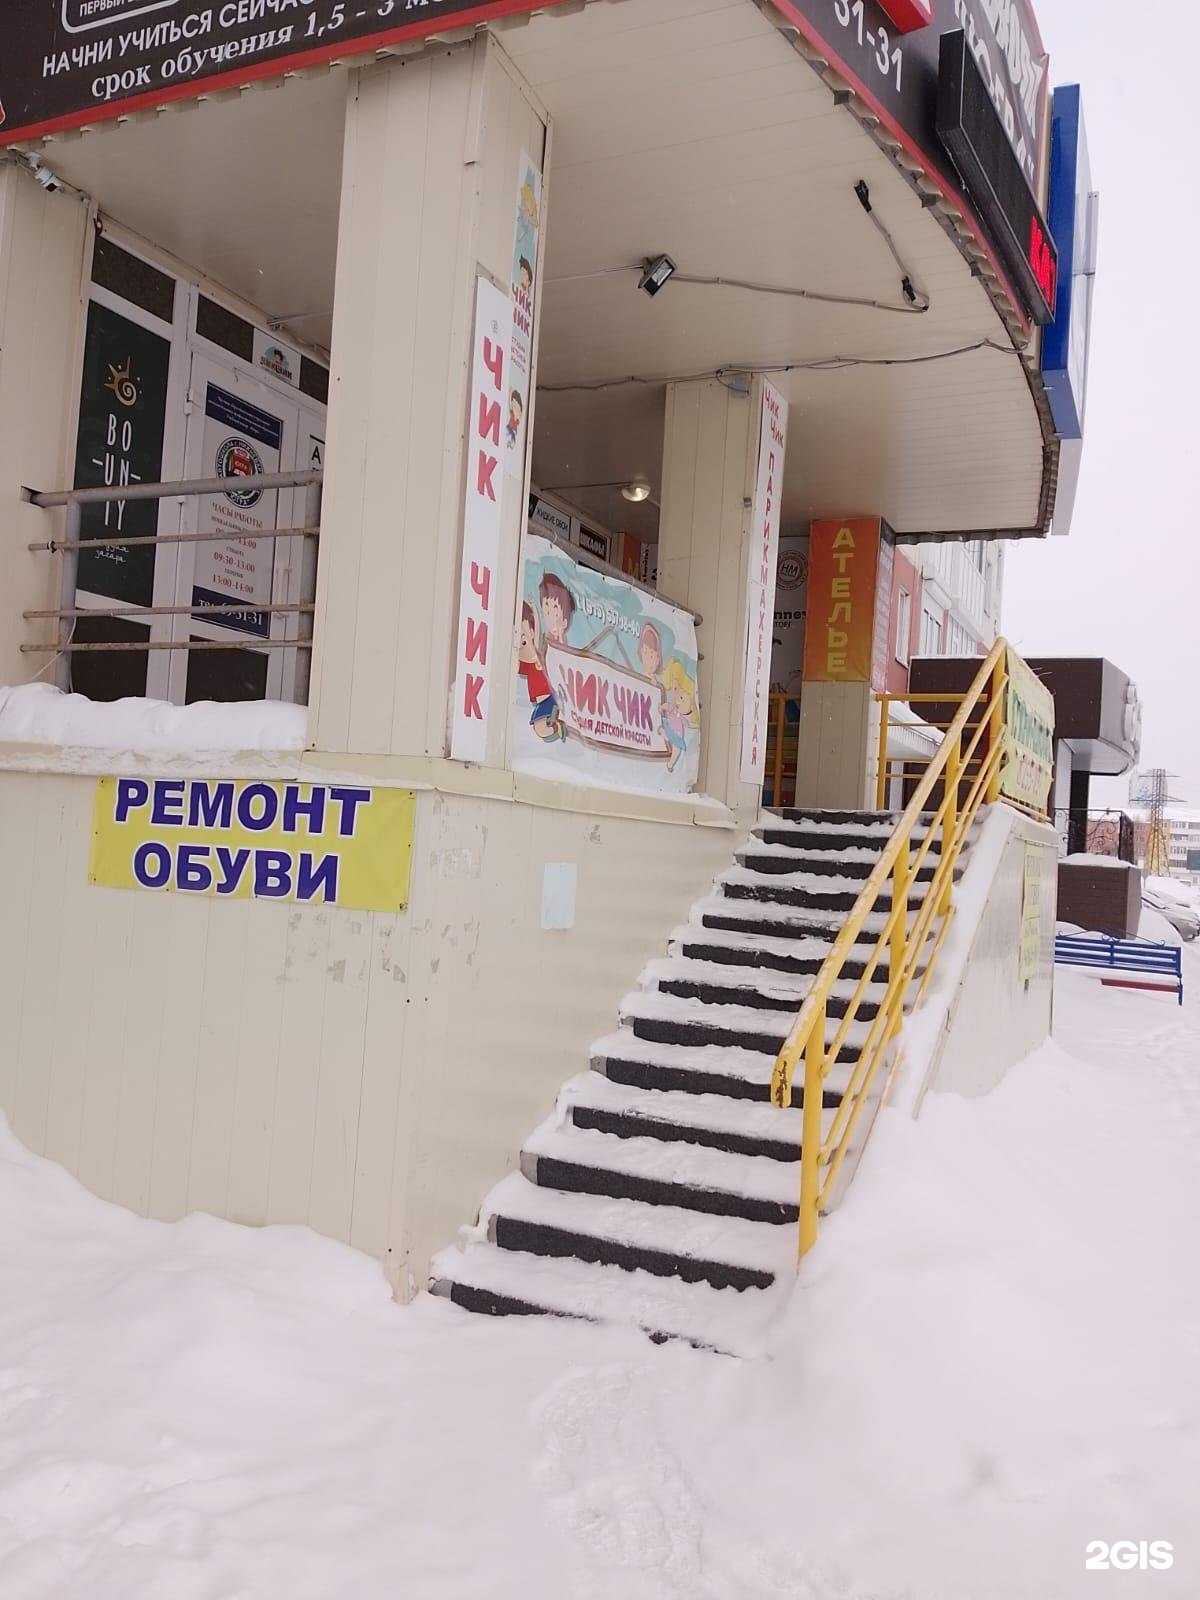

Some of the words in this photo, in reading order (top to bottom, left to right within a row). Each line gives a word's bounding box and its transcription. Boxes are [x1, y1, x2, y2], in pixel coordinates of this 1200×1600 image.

[42, 38, 113, 77] НАЧНИ
[118, 15, 213, 57] УЧИТЬСЯ
[219, 0, 314, 28] СЕЙЧА
[91, 63, 151, 100] срок
[160, 25, 294, 78] обучения
[303, 4, 345, 37] 1,5
[477, 335, 504, 502] ЧИК
[765, 390, 779, 420] ЧИК
[770, 420, 784, 448] ЧИК
[751, 452, 775, 766] ПАРИКМАХЕРСКАЯ
[827, 527, 856, 673] АТЕЛЬЕ
[464, 561, 491, 720] ЧИК
[558, 664, 611, 719] ЧИК
[613, 683, 653, 732] ЧИК
[114, 779, 371, 836] РЕМОНТ
[133, 842, 339, 903] ОБУВИ
